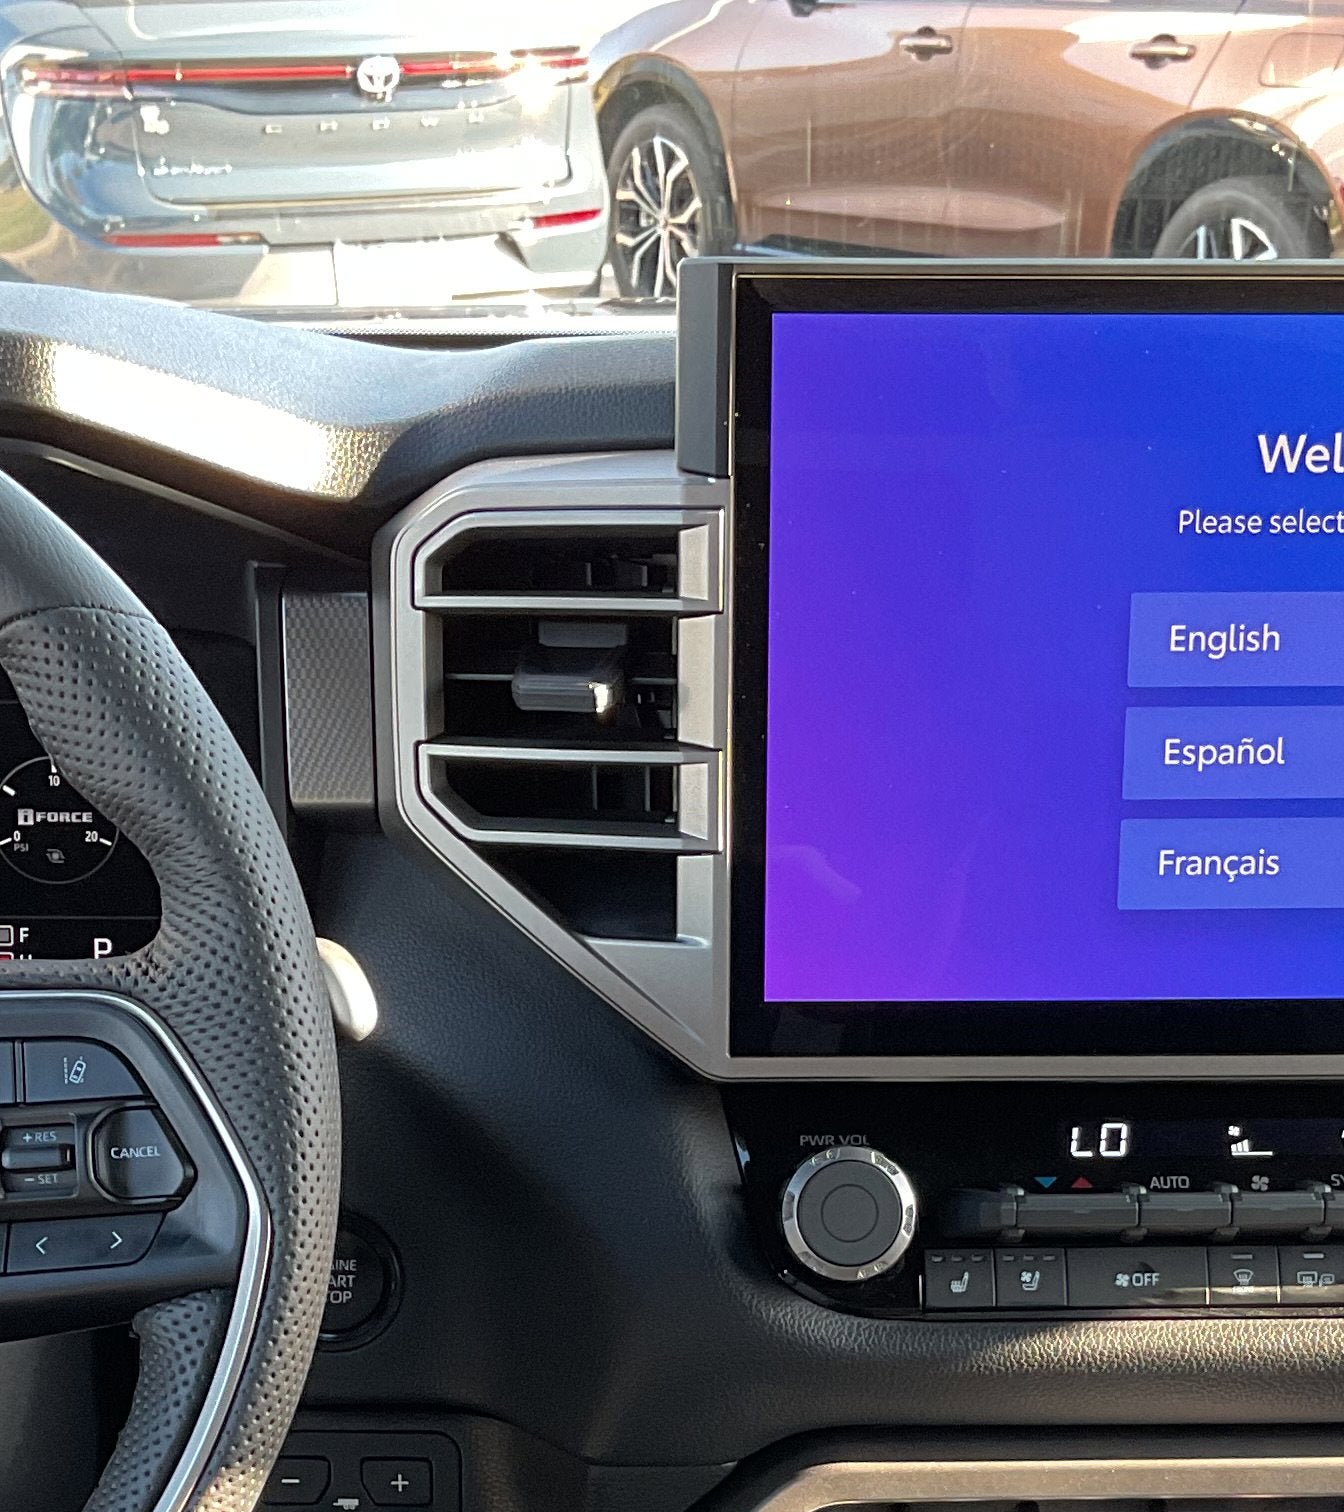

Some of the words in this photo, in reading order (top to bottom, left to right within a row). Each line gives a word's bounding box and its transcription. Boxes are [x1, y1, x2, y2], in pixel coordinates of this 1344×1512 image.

[1178, 510, 1262, 534] Please
[1169, 623, 1281, 659] English
[1163, 737, 1285, 772] Español
[48, 774, 60, 787] 10
[13, 831, 21, 842] 0
[85, 830, 99, 843] 20
[13, 842, 29, 853] PSI
[1158, 849, 1280, 883] Français
[19, 927, 30, 943] F
[94, 938, 113, 960] P
[799, 1133, 835, 1147] PWR
[838, 1133, 870, 1147] VOL
[1070, 1121, 1130, 1159] LO
[110, 1146, 161, 1160] CANCEL
[1150, 1175, 1190, 1190] AUTO
[331, 1259, 358, 1271] INE
[1132, 1271, 1161, 1288] OFF
[328, 1290, 353, 1304] OP
